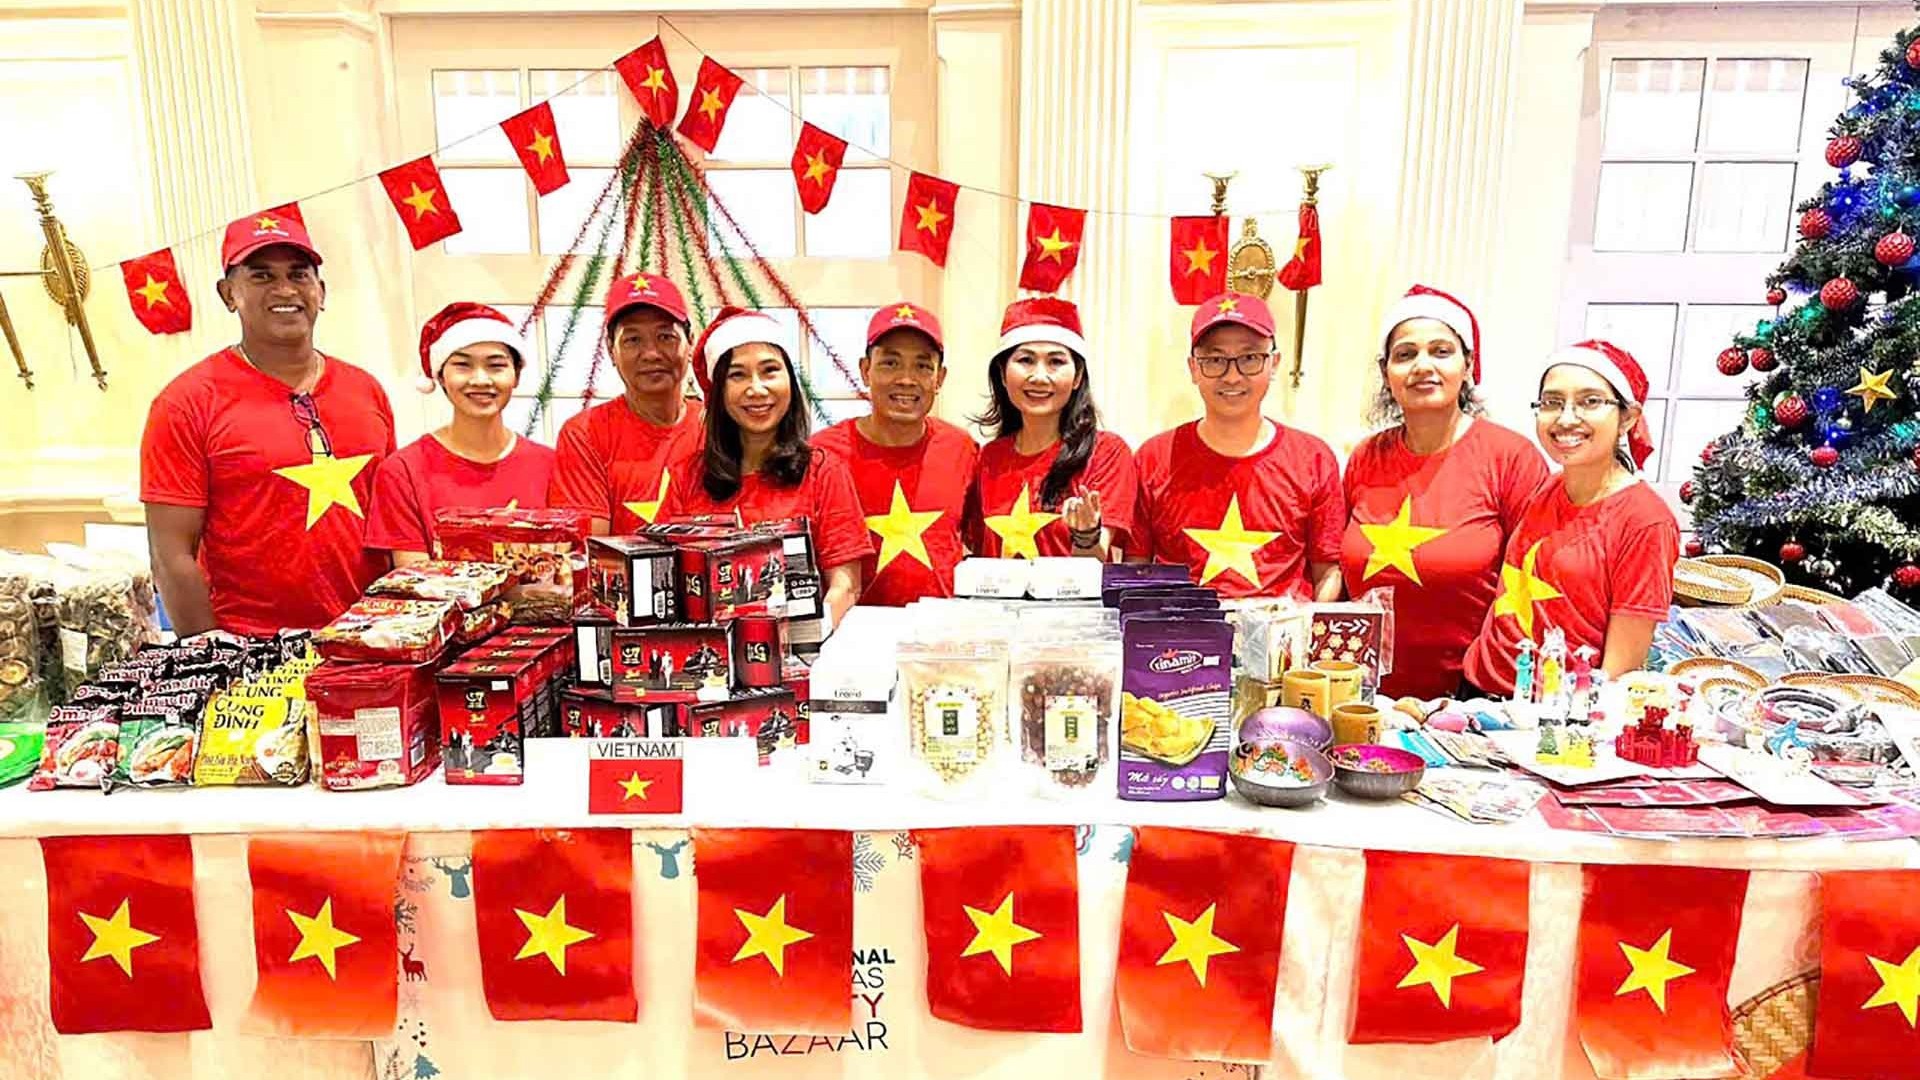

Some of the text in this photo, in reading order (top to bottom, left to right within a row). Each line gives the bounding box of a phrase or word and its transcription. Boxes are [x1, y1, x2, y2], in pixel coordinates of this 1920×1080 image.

[597, 742, 676, 757] VIETNAM
[852, 948, 896, 965] NAL
[852, 967, 884, 988] AS
[725, 1021, 888, 1060] BAZAAR
